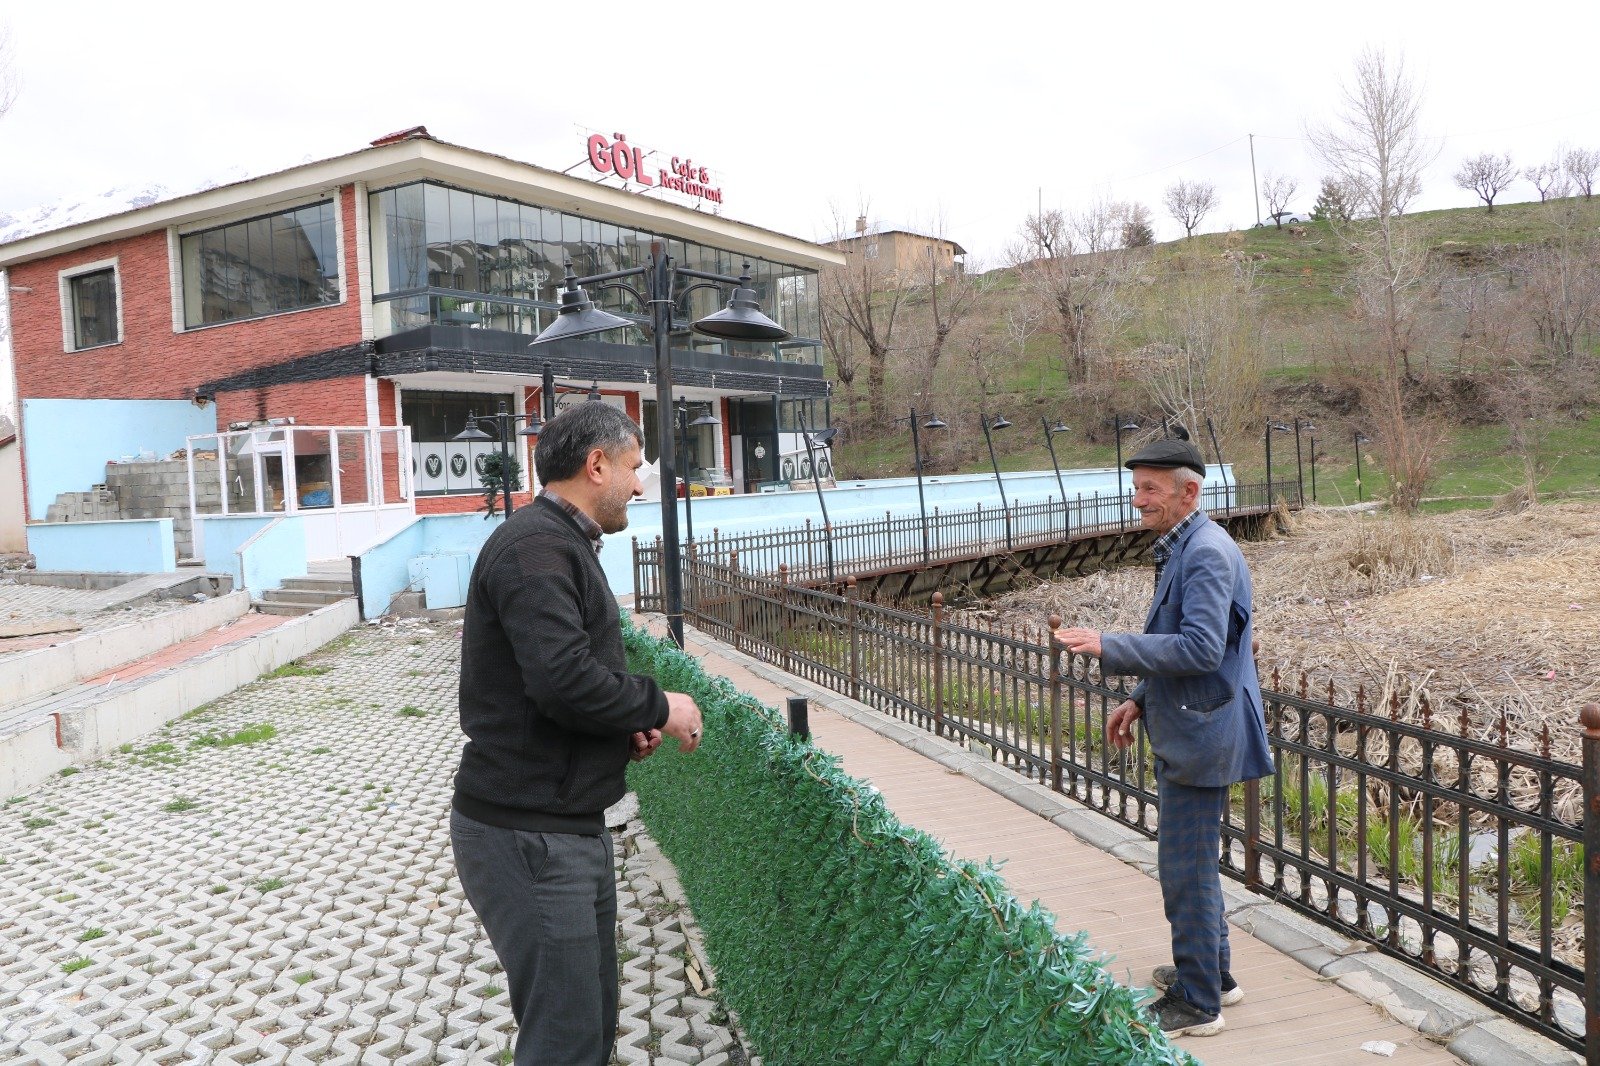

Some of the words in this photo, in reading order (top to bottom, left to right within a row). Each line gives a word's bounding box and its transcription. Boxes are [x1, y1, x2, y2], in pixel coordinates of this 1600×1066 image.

[588, 132, 653, 186] GÖL
[671, 156, 697, 181] Cafe
[699, 166, 710, 184] &
[660, 169, 723, 203] Restaurant
